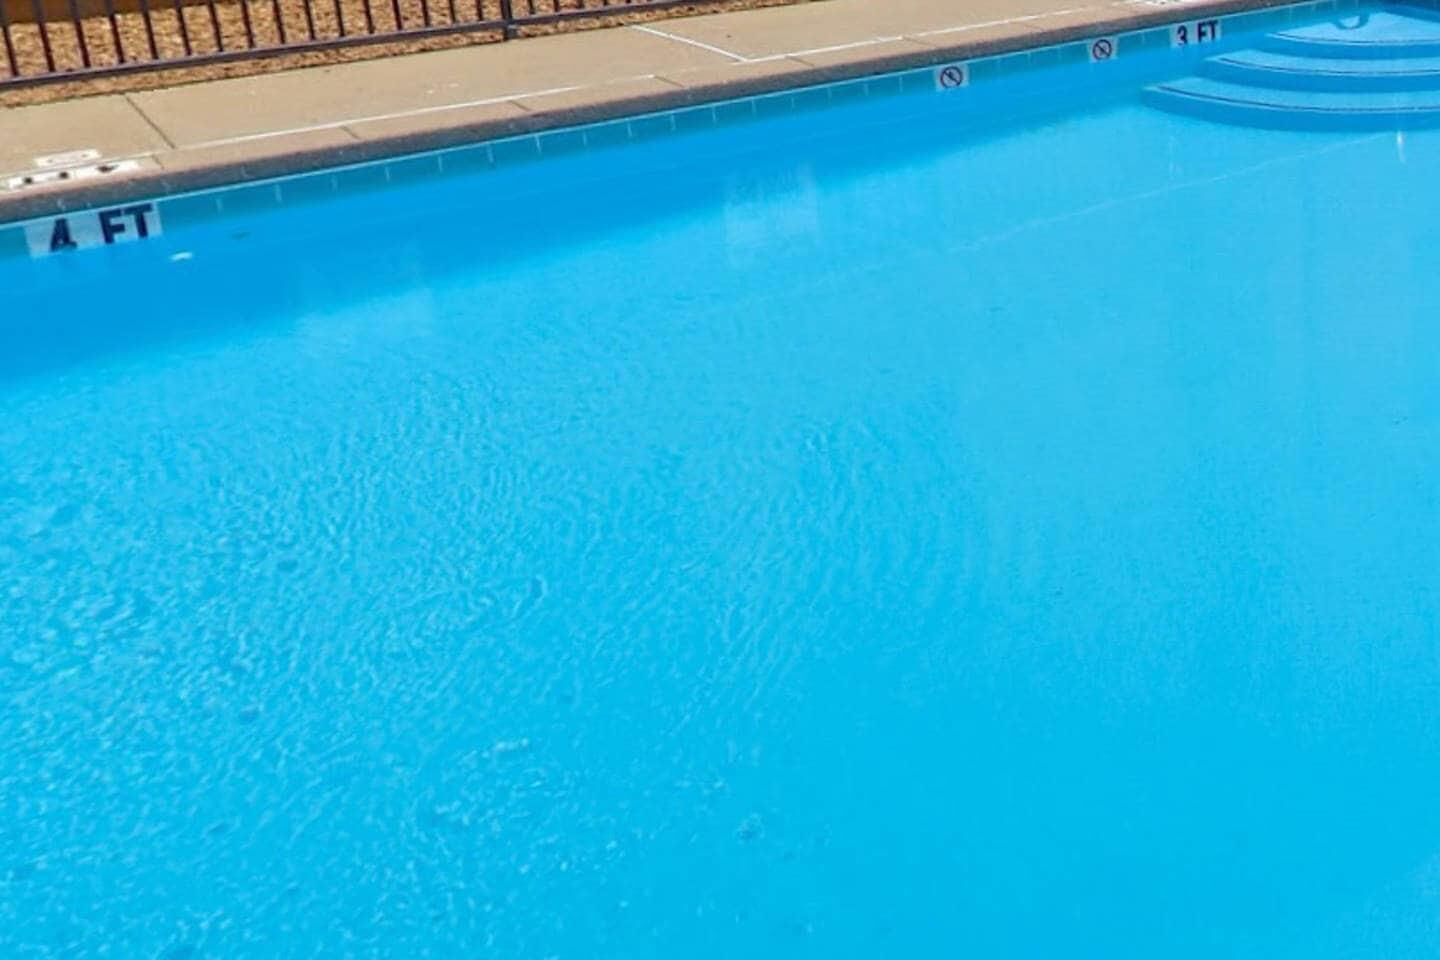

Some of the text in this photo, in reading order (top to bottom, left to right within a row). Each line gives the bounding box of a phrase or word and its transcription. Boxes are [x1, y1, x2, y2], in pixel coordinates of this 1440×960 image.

[1176, 20, 1219, 46] 3 FT
[98, 203, 153, 245] FT
